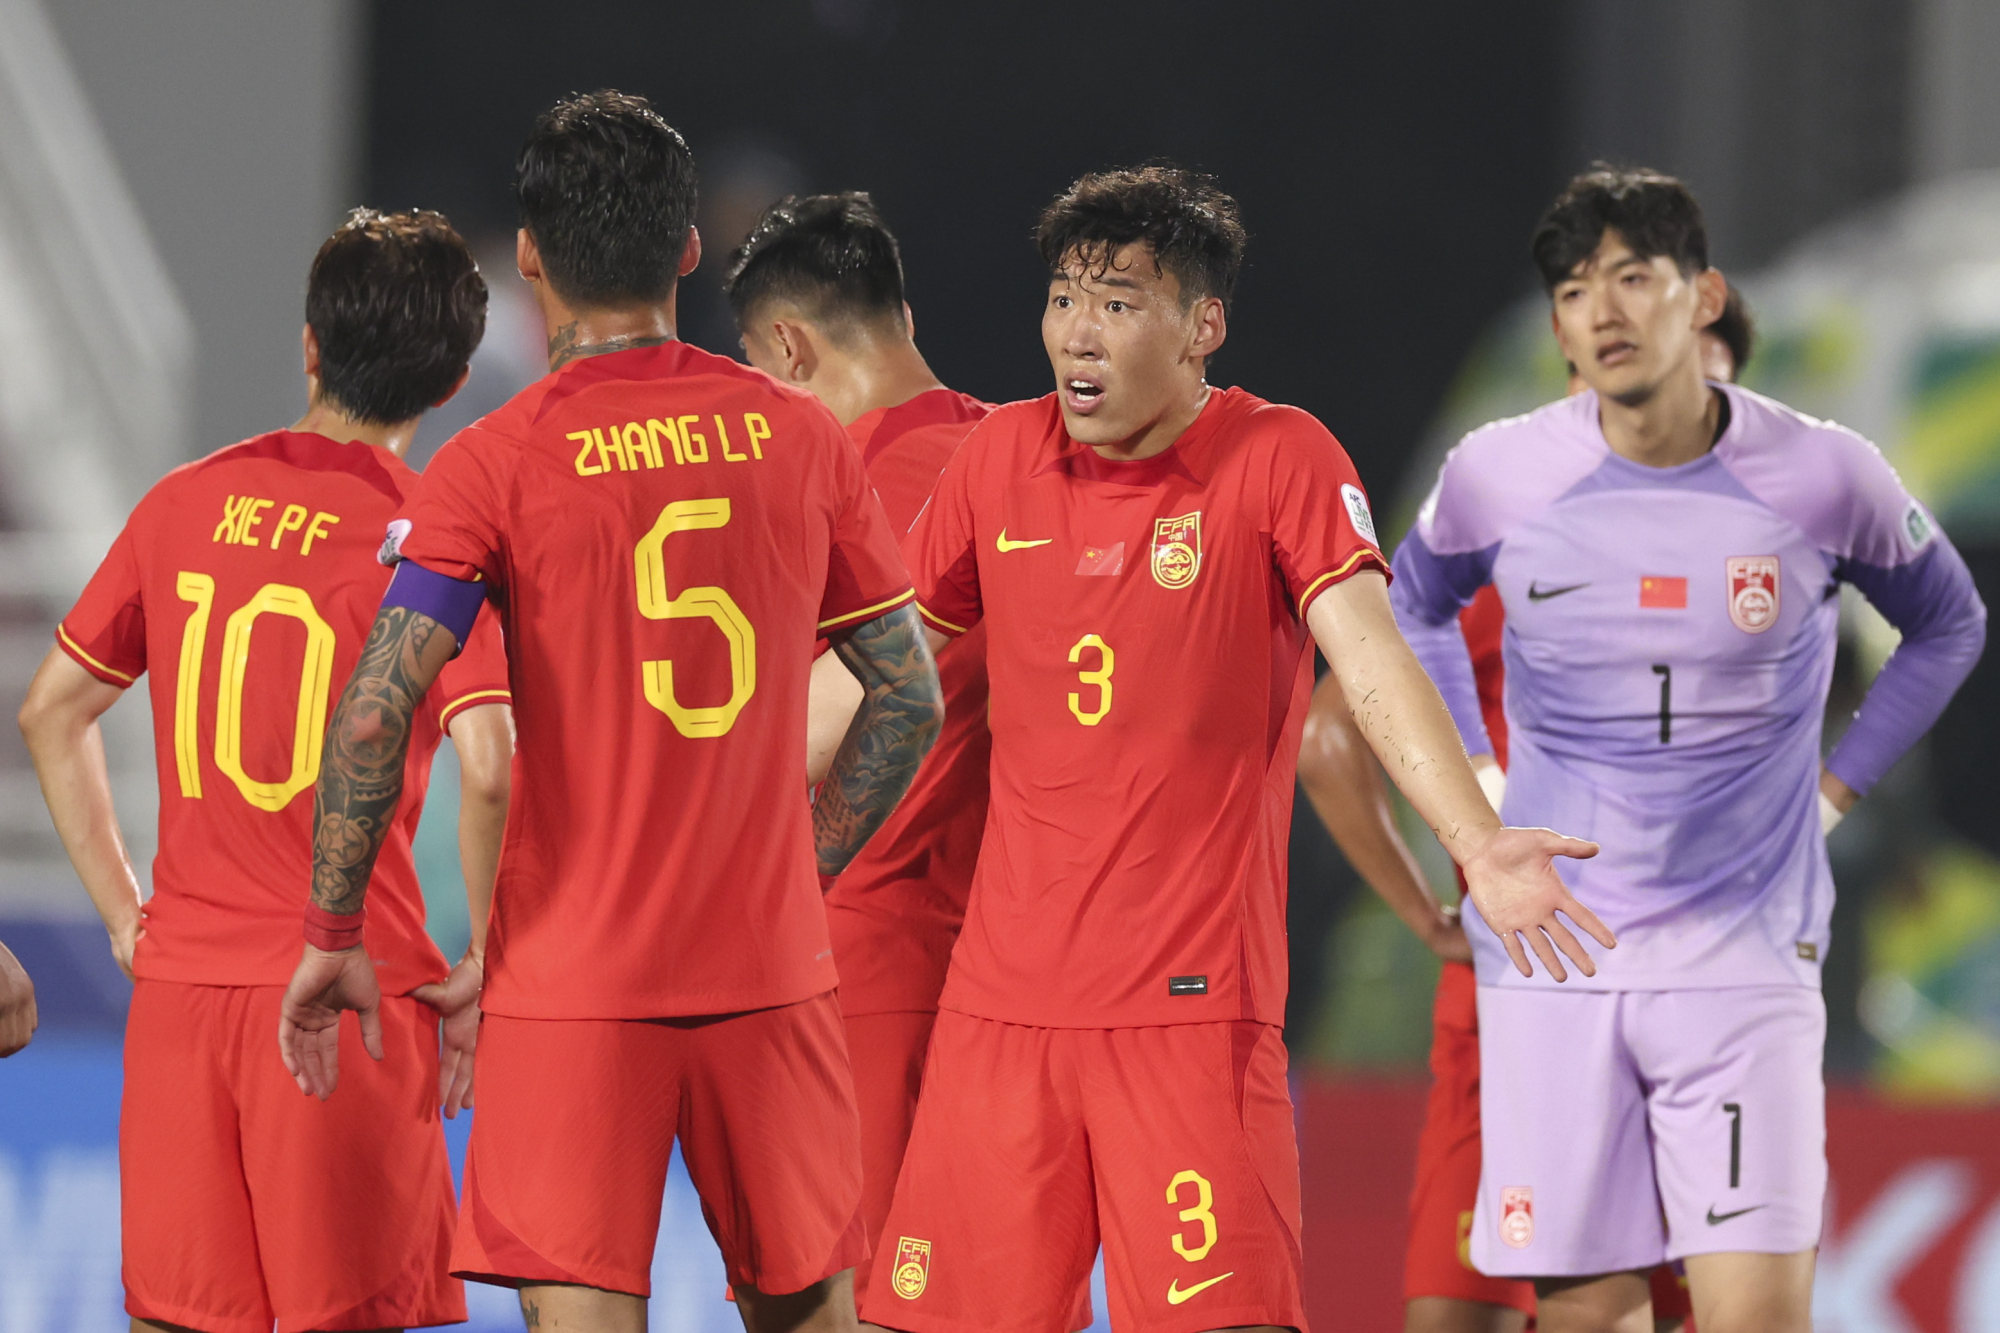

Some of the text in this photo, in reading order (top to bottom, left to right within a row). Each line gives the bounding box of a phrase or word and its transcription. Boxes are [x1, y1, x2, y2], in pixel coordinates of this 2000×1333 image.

[565, 415, 709, 476] ZHANG
[212, 494, 275, 546] XIE
[1159, 517, 1195, 535] CFA
[634, 497, 757, 739] 5
[173, 570, 337, 812] 10
[1067, 633, 1115, 726] 3
[1651, 665, 1672, 744] 1
[1723, 1103, 1741, 1188] 1
[902, 1241, 928, 1256] CFA
[1165, 1169, 1218, 1262] 3
